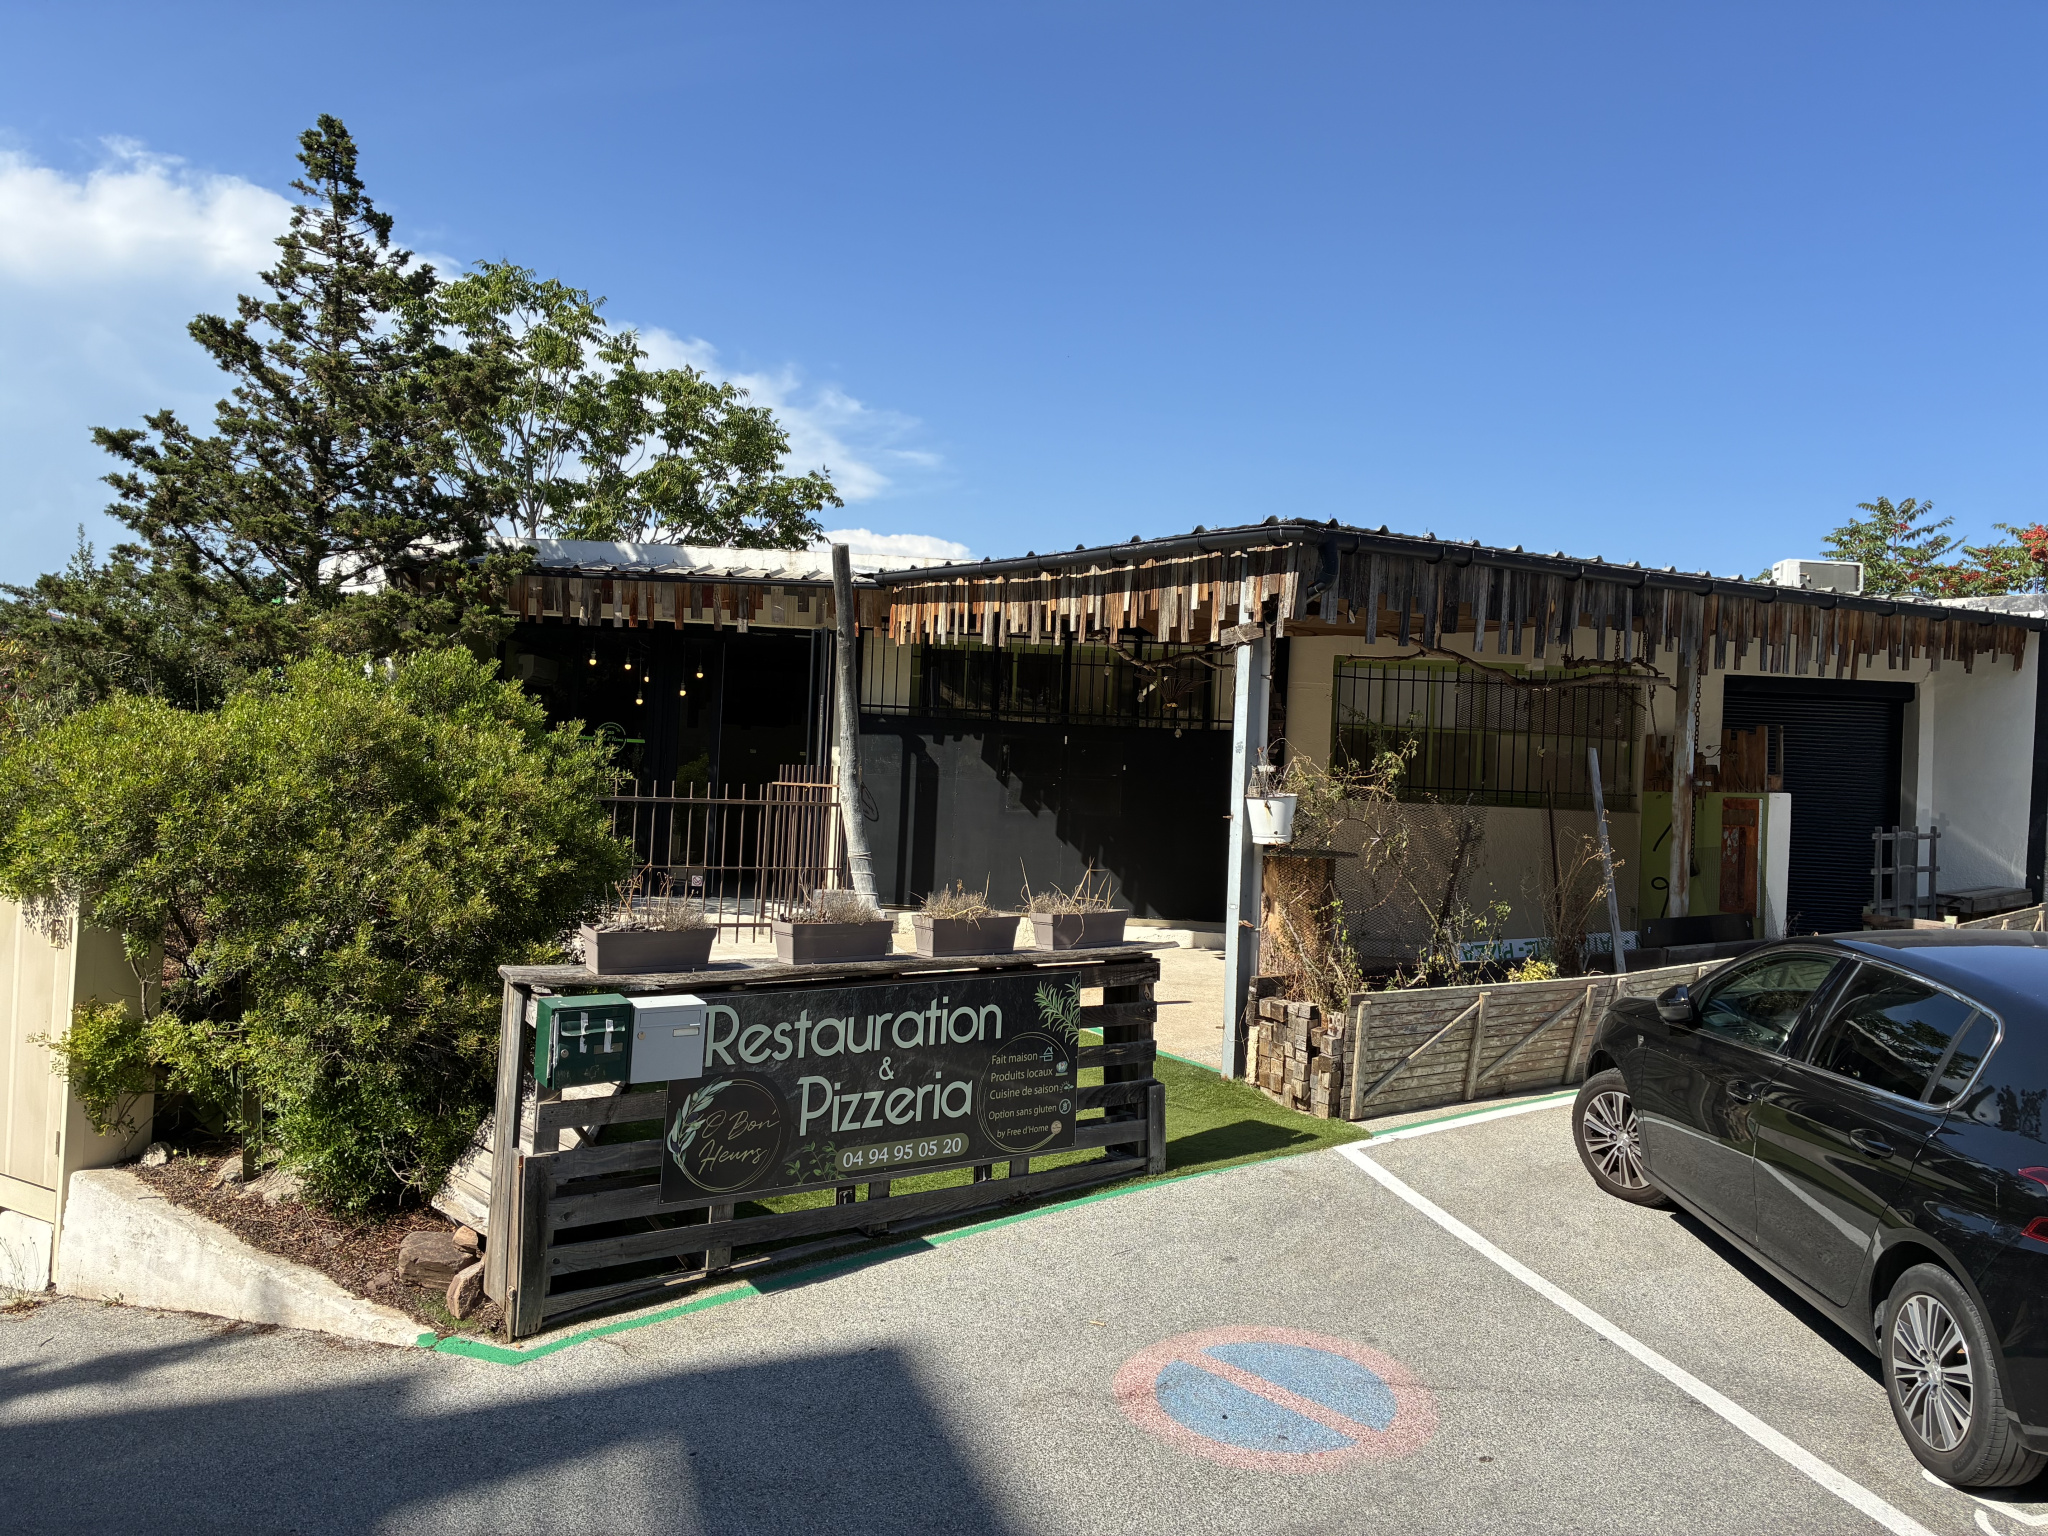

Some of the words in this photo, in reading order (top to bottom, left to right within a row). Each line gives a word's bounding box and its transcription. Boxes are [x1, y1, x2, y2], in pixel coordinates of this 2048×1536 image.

[704, 996, 1003, 1068] Restauration
[878, 1056, 894, 1081] &
[991, 1054, 1006, 1065] Fait
[1008, 1053, 1038, 1063] maison
[990, 1070, 1025, 1082] Produits
[1026, 1068, 1053, 1079] locaux
[989, 1088, 1020, 1100] Cuisine
[1021, 1086, 1032, 1096] de
[1033, 1084, 1059, 1094] saison
[797, 1071, 973, 1137] Pizzeria
[988, 1109, 1015, 1121] Option
[1016, 1108, 1032, 1116] sans
[1033, 1104, 1057, 1117] gluten
[996, 1129, 1005, 1139] by
[1006, 1128, 1022, 1137] Free
[1022, 1124, 1049, 1134] d'Home
[698, 1138, 768, 1175] Heurs
[842, 1150, 864, 1168] 04
[868, 1147, 889, 1165] 94
[893, 1143, 914, 1161] 95
[918, 1140, 938, 1158] 05
[942, 1137, 962, 1154] 20
